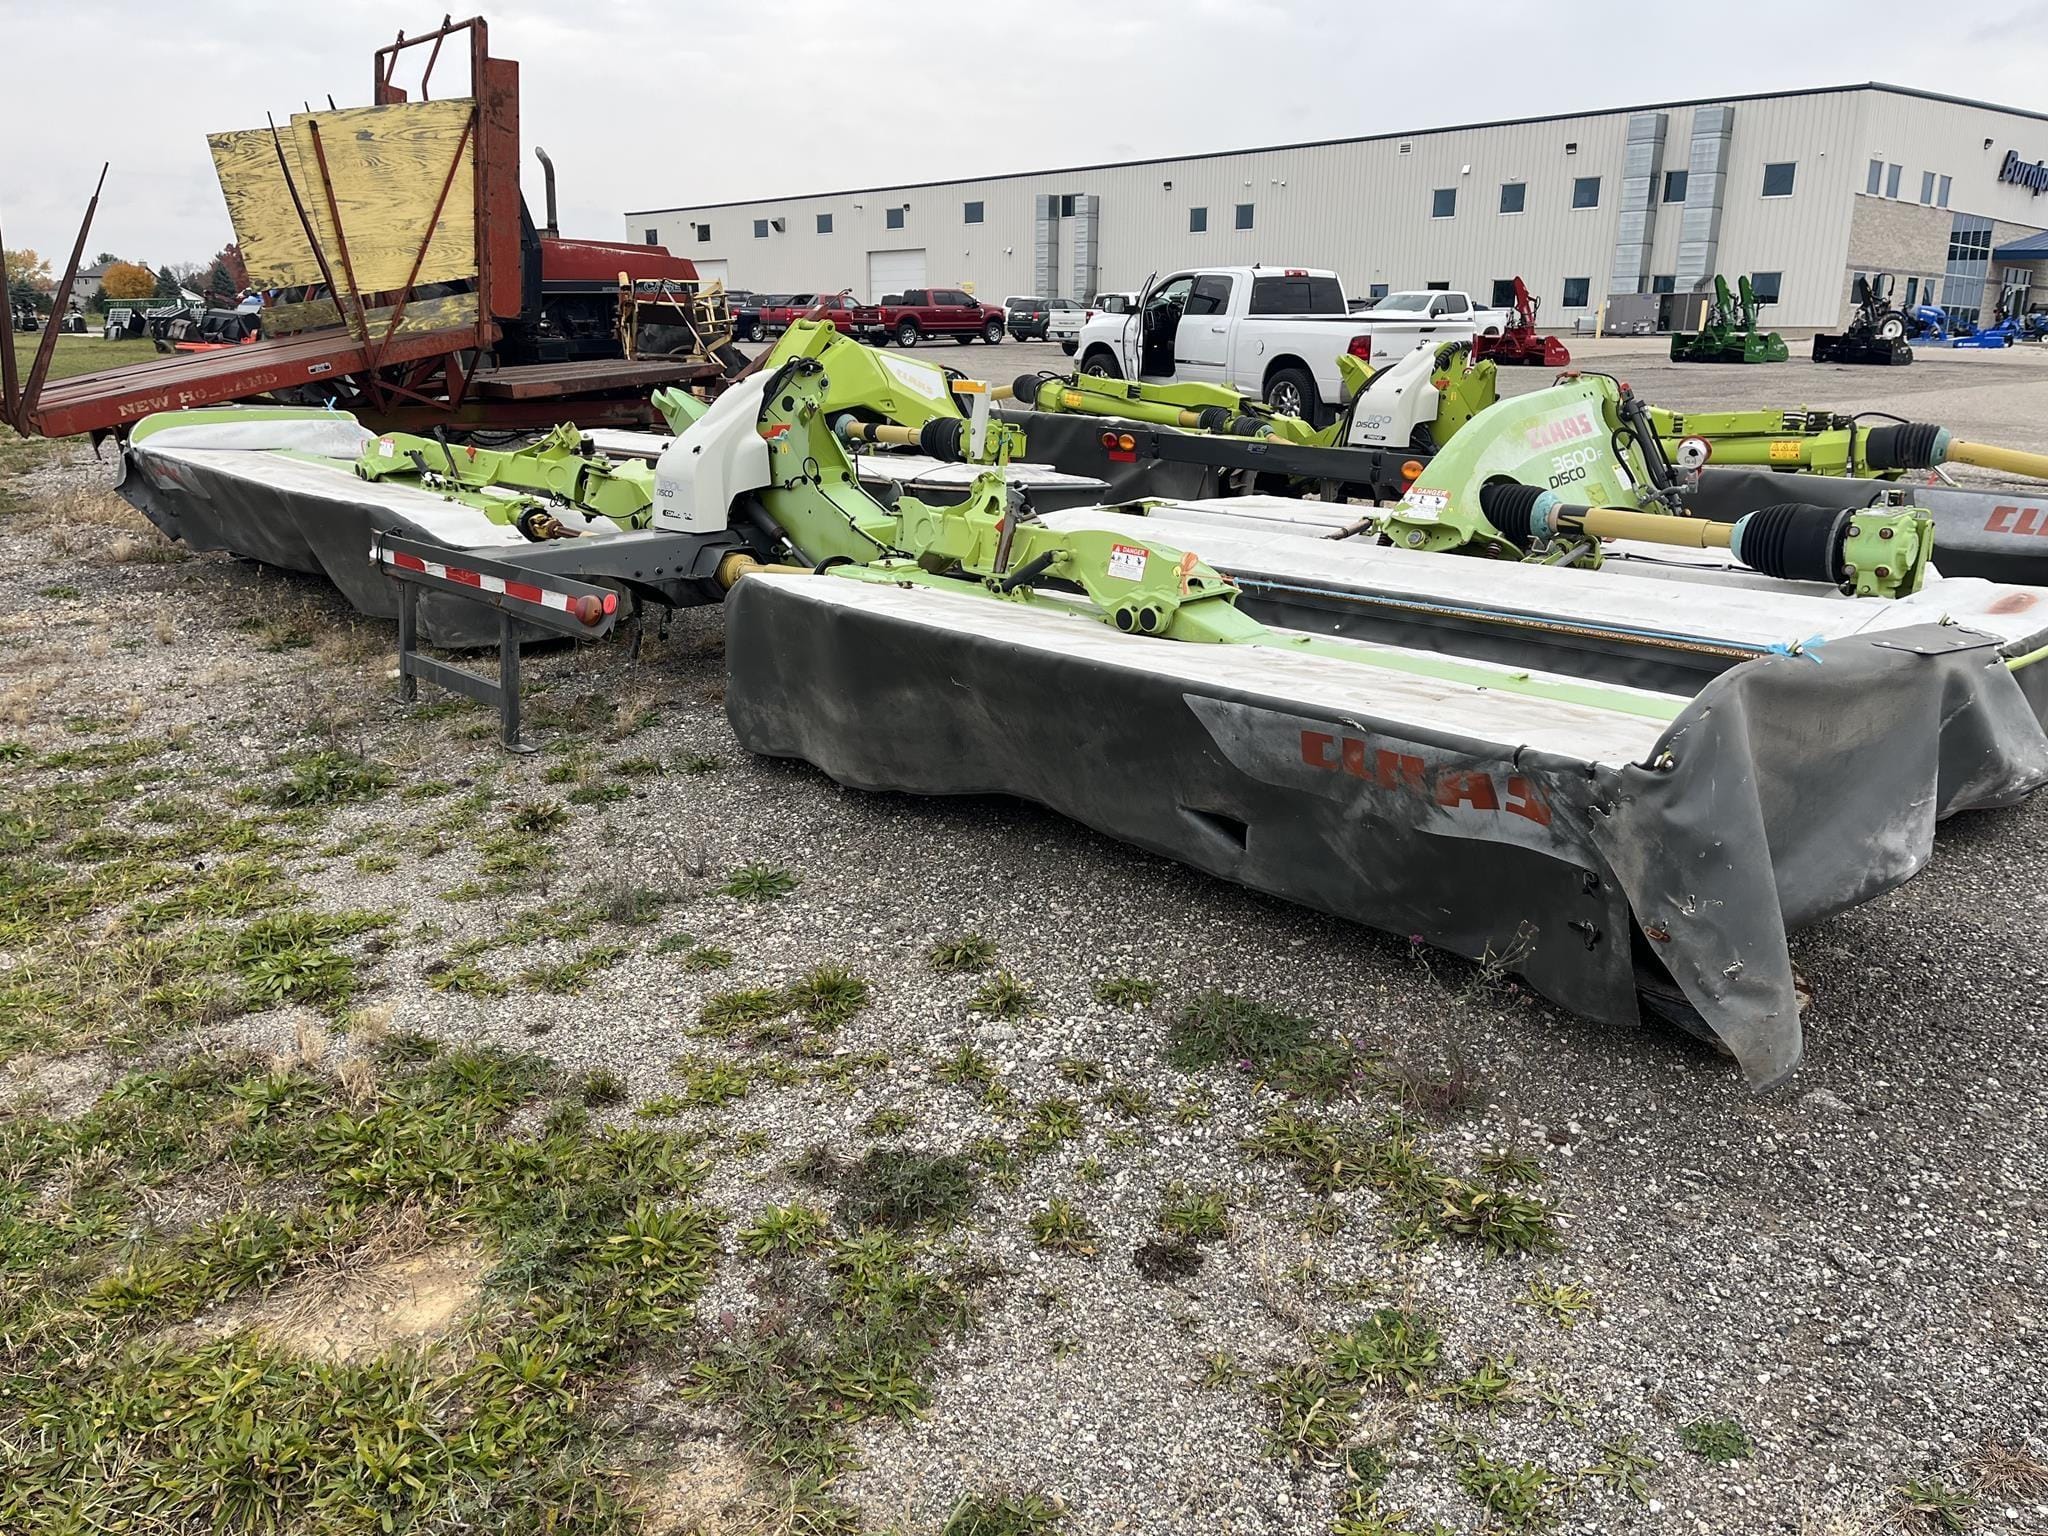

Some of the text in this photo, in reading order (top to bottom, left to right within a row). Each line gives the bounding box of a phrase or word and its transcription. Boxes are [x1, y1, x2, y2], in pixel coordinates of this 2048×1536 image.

[118, 395, 169, 417] NEW
[1356, 421, 1380, 429] DISCO
[1526, 413, 1593, 449] CLAAS
[1548, 466, 1587, 489] DISCO
[1416, 488, 1447, 497] DANGER
[1122, 546, 1145, 556] DANGER
[1300, 730, 1552, 826] CLAAS
